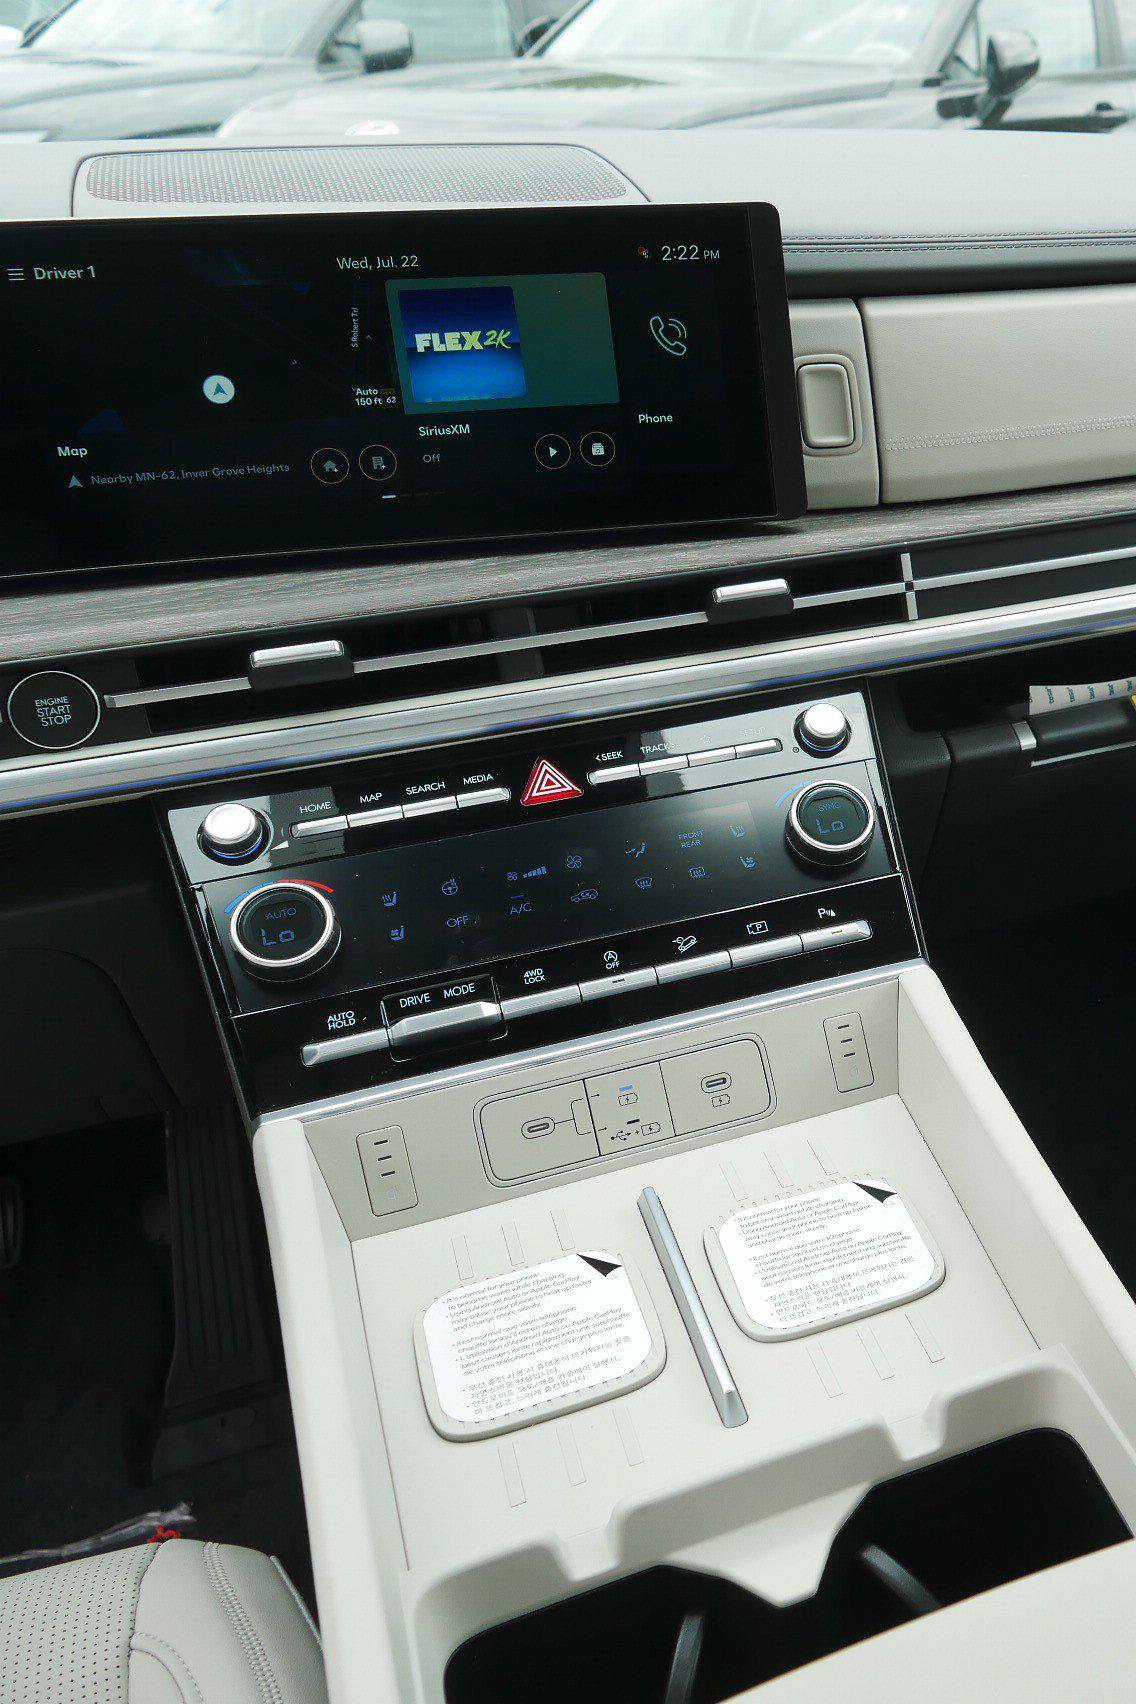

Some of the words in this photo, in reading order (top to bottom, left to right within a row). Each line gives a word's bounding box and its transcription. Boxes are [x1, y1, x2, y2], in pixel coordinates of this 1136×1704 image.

[661, 244, 700, 261] 2:22
[703, 250, 720, 260] PM
[336, 257, 372, 270] Wed,
[377, 256, 398, 268] Jul.
[401, 255, 419, 267] 22
[34, 267, 85, 281] Driver
[88, 266, 96, 278] 1
[351, 318, 359, 342] Robert
[415, 331, 484, 352] FLEX
[483, 329, 512, 349] 2K
[355, 398, 372, 406] 150
[374, 397, 383, 405] ft
[638, 412, 674, 424] Phone
[418, 422, 471, 437] SiriusXM
[57, 445, 88, 458] Map
[423, 452, 441, 463] Off
[90, 474, 132, 485] Nearby
[135, 470, 180, 482] MN-62,
[181, 469, 210, 479] Inver
[212, 467, 245, 477] Grove
[247, 464, 290, 475] Heights
[35, 696, 69, 707] ENGINE
[37, 705, 71, 718] START
[41, 715, 72, 727] STOP
[640, 742, 669, 755] TRACK
[600, 751, 623, 762] SEEK
[463, 773, 494, 785] MEDIA
[405, 781, 446, 795] SEARCH
[359, 792, 382, 804] MAP
[299, 801, 332, 814] HOME
[265, 907, 297, 920] AUTO
[509, 902, 532, 915] A/C
[446, 915, 469, 928] OFF
[605, 960, 620, 970] OFF
[523, 968, 543, 978] 4WD
[524, 974, 546, 985] LOCK
[400, 993, 431, 1008] DRIVE
[443, 983, 476, 999] MODE
[327, 1010, 355, 1023] AUTO
[328, 1018, 356, 1031] HOLD
